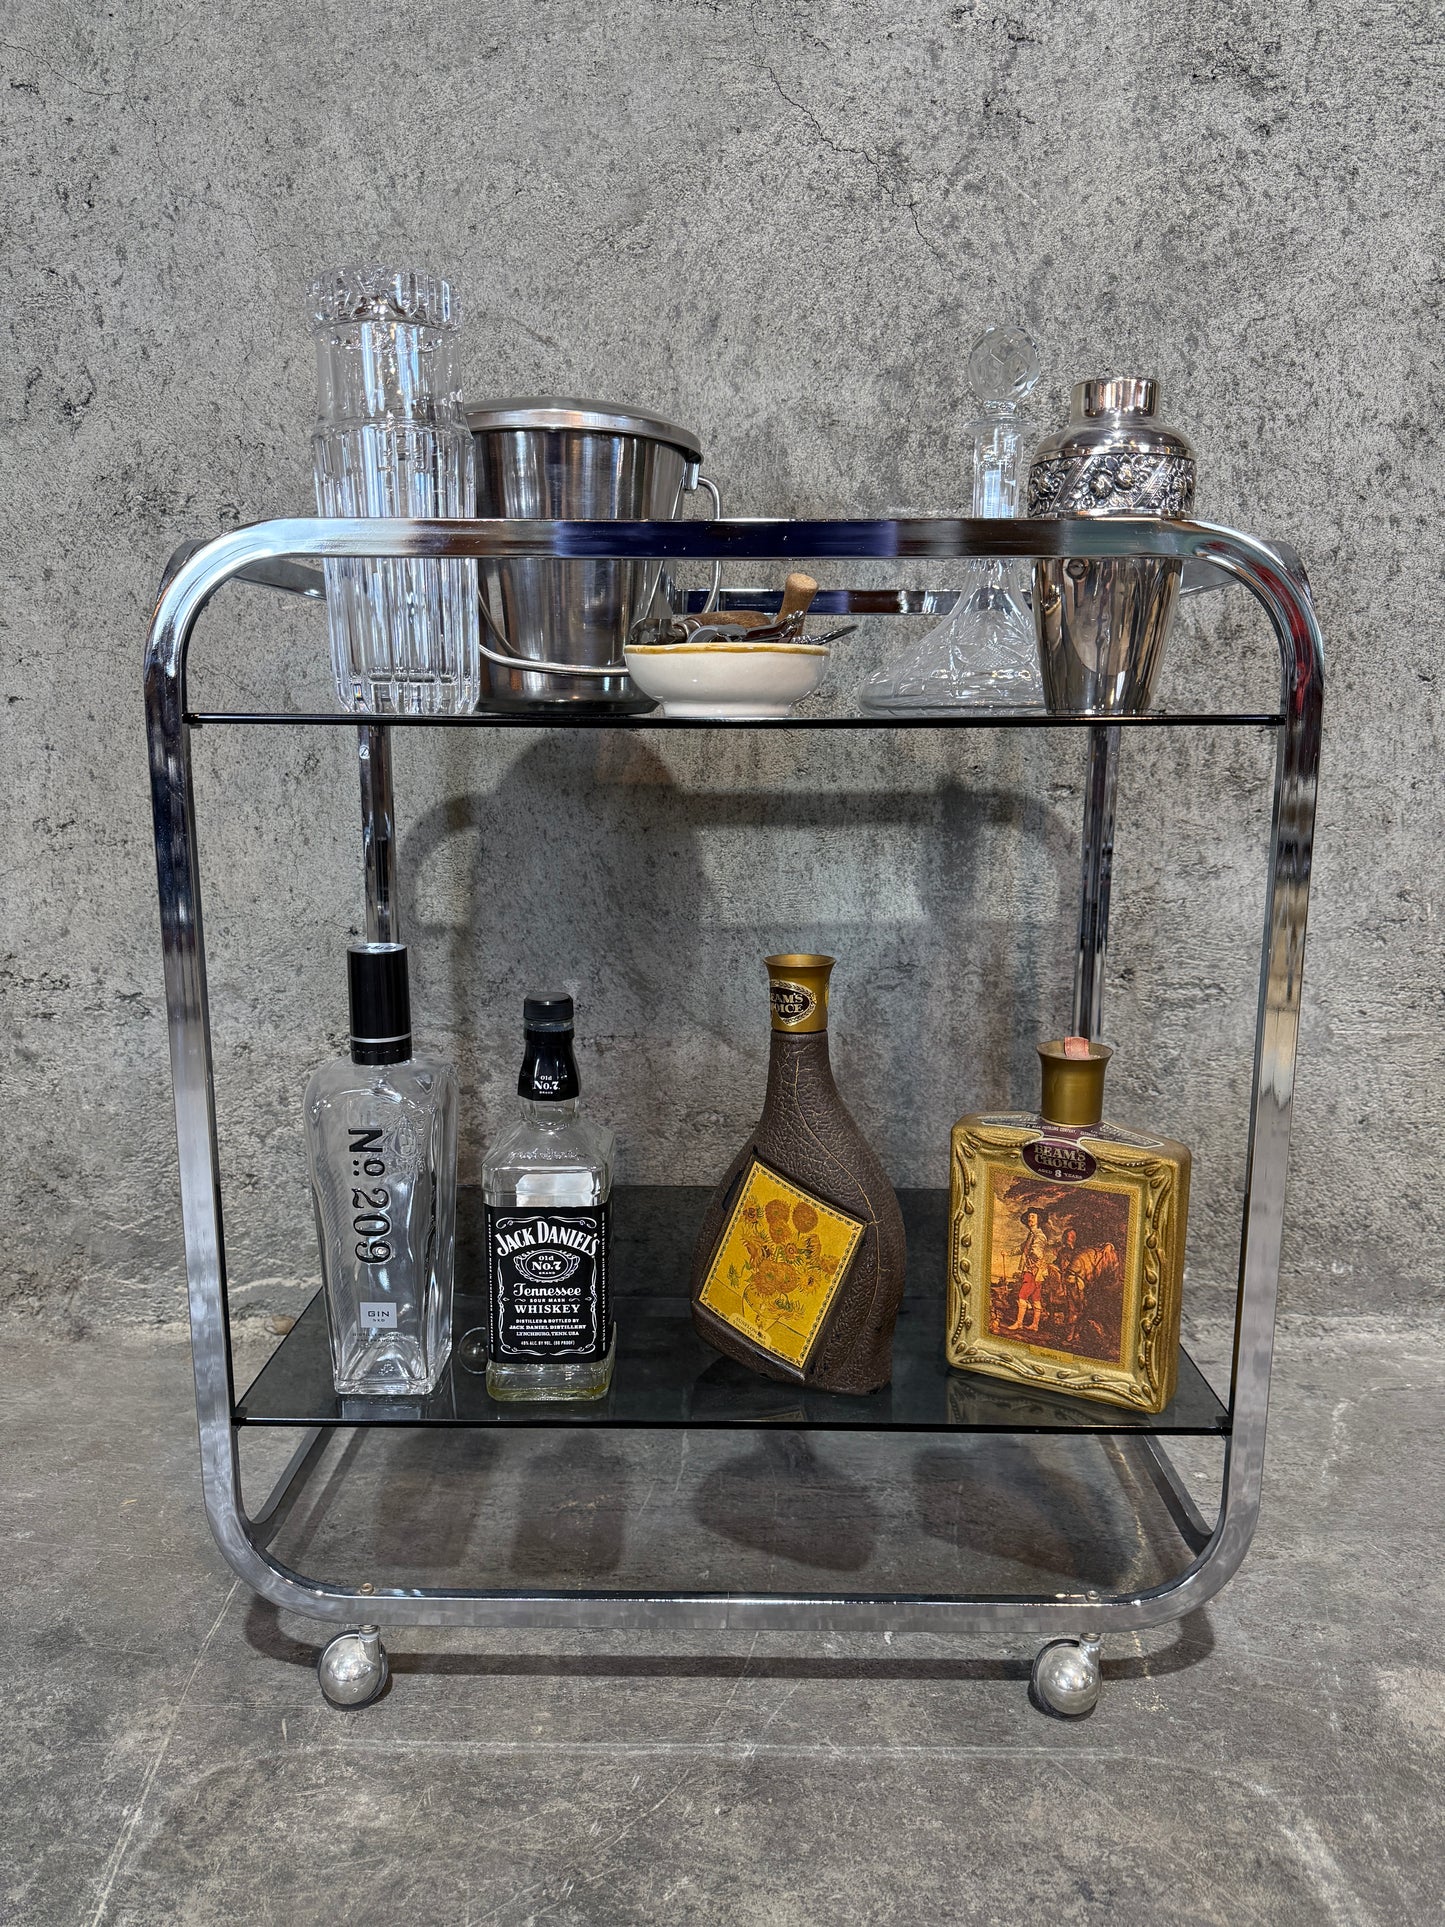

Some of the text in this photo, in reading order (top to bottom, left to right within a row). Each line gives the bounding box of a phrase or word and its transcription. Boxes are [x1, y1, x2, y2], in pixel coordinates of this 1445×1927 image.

[770, 992, 804, 1004] EAM'S
[1034, 1144, 1086, 1161] BEAM'S
[1034, 1154, 1087, 1171] CHOICE
[1054, 1169, 1062, 1178] 8
[1063, 1172, 1083, 1180] YEARS
[351, 1187, 391, 1264] 209
[494, 1220, 600, 1257] JACK DANIEL'S
[531, 1261, 562, 1271] No.7
[513, 1282, 582, 1297] Tennessee
[514, 1304, 581, 1314] WHISKEY
